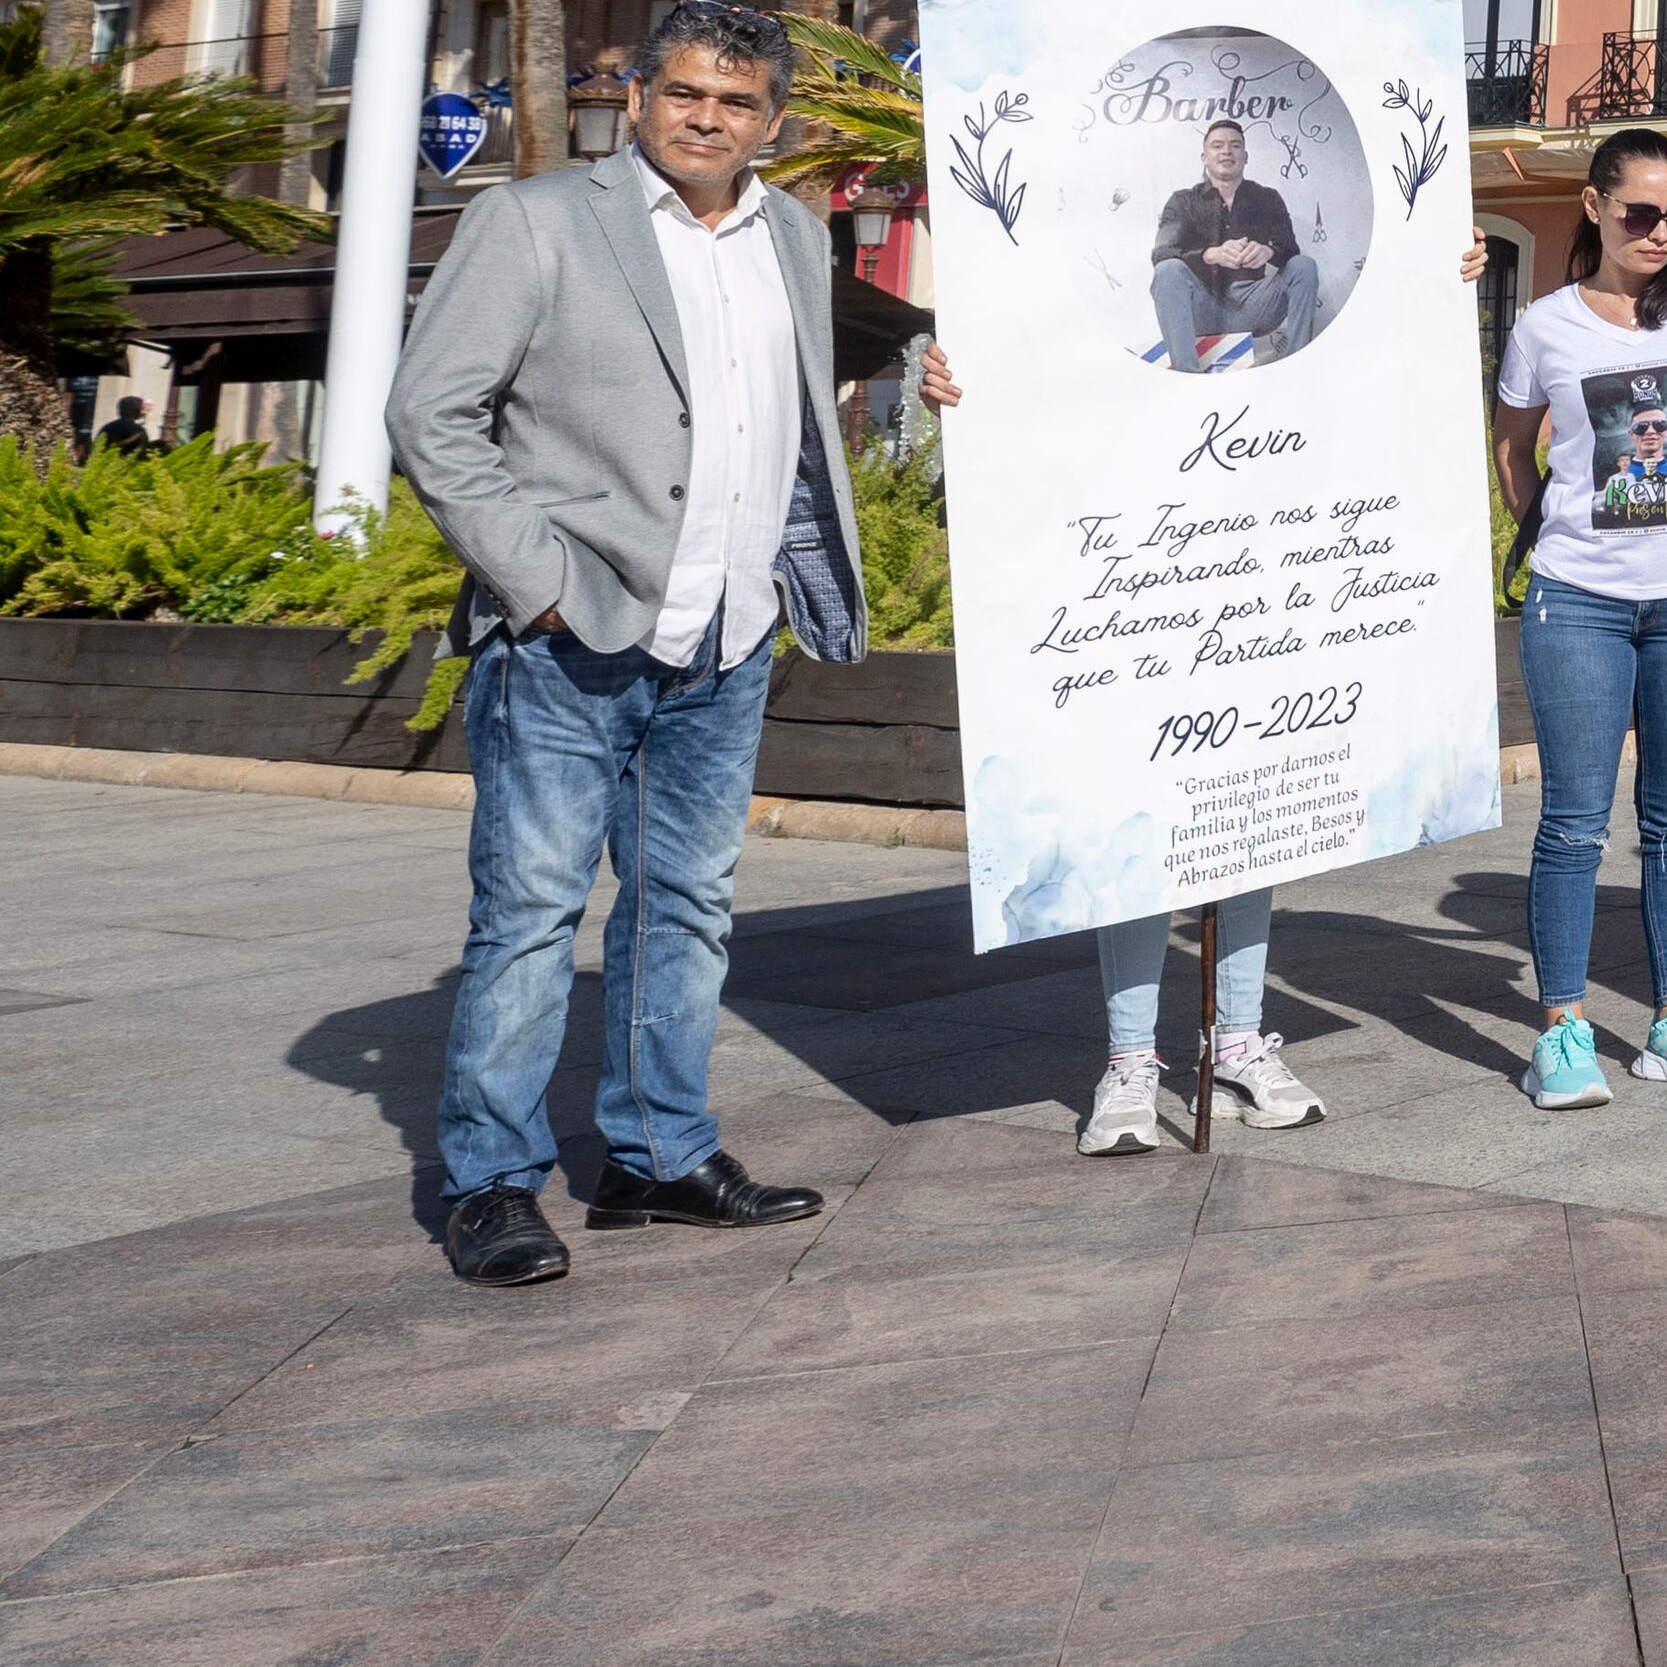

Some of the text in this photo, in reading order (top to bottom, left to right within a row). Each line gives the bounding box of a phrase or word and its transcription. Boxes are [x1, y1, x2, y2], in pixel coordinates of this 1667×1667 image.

[1104, 64, 1295, 126] Barber
[1179, 405, 1307, 473] Kevin
[1138, 502, 1259, 558] Ingenio
[1271, 504, 1317, 527] nos
[1330, 494, 1401, 533] sigue
[1083, 535, 1395, 602] Inspirando, mientras
[1030, 567, 1441, 655] Luchamos por la Justicia
[1052, 669, 1119, 709] que
[1133, 654, 1172, 680] tu
[1190, 627, 1307, 676] Partida
[1149, 681, 1364, 762] 1990-2023
[1192, 771, 1340, 822] privilegio de ser tu
[1253, 764, 1279, 786] por
[1281, 750, 1335, 774] darnos
[1338, 743, 1351, 761] el
[1164, 848, 1196, 872] que
[1200, 842, 1229, 861] nos
[1311, 810, 1352, 832] Besos
[1356, 807, 1365, 827] y
[1171, 788, 1359, 849] familia y los momentos
[1178, 859, 1245, 888] Abrazos
[1249, 845, 1293, 871] hasta
[1297, 839, 1308, 859] el
